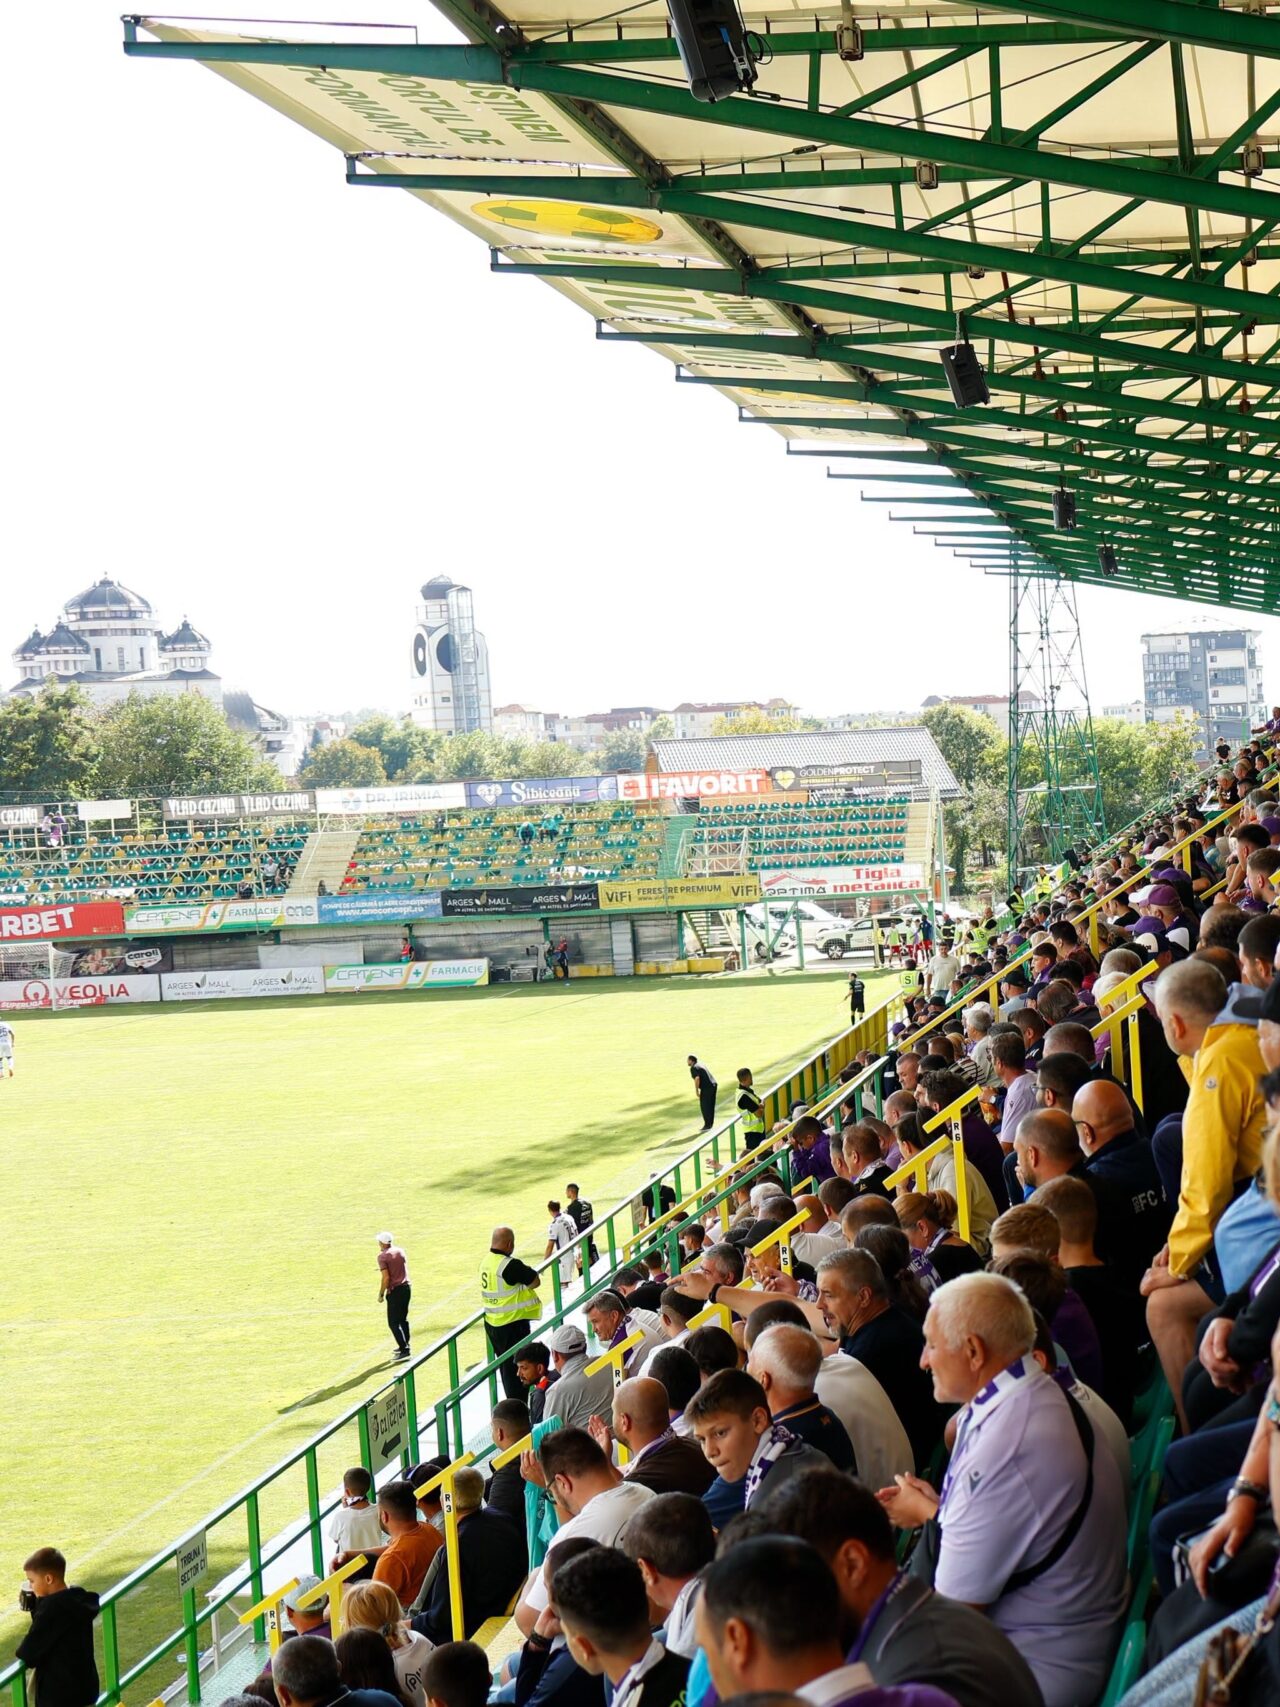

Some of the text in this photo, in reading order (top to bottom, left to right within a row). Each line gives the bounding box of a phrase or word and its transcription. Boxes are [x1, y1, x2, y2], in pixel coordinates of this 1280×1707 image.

[800, 765, 875, 777] GOLDENPROTECT
[651, 774, 762, 797] FAVORIT
[365, 789, 443, 803] DR. IRIMIA
[511, 781, 581, 803] Sibiceanu
[168, 796, 236, 818] VLAD CAZINO
[241, 792, 310, 814] VLAD CAZINO
[0, 806, 38, 825] CAZINO
[637, 884, 722, 895] FERESRE PREMIUM
[731, 884, 758, 897] ViFi
[447, 897, 512, 907] ARGES MALL
[532, 893, 597, 904] ARGES MALL
[605, 891, 632, 903] ViFi
[135, 904, 279, 923] CATENA FARMACIE
[127, 949, 160, 960] caroli
[336, 965, 483, 981] CATENA FARMACIE
[167, 980, 231, 989] ARGES MALL
[252, 976, 318, 986] ARGES MALL
[904, 975, 912, 985] S
[54, 983, 130, 999] VEOLIA
[1, 1000, 44, 1008] SUPERLIGA
[1130, 1014, 1136, 1023] 7
[953, 1122, 960, 1131] R
[955, 1133, 961, 1142] 6
[781, 1246, 788, 1255] R
[782, 1257, 789, 1266] 5
[614, 1369, 621, 1378] R
[444, 1493, 451, 1502] R
[445, 1504, 452, 1513] 3
[180, 1547, 200, 1569] TRIBUNA
[180, 1562, 200, 1586] SECTOR
[269, 1610, 276, 1618] R
[270, 1621, 277, 1630] 2
